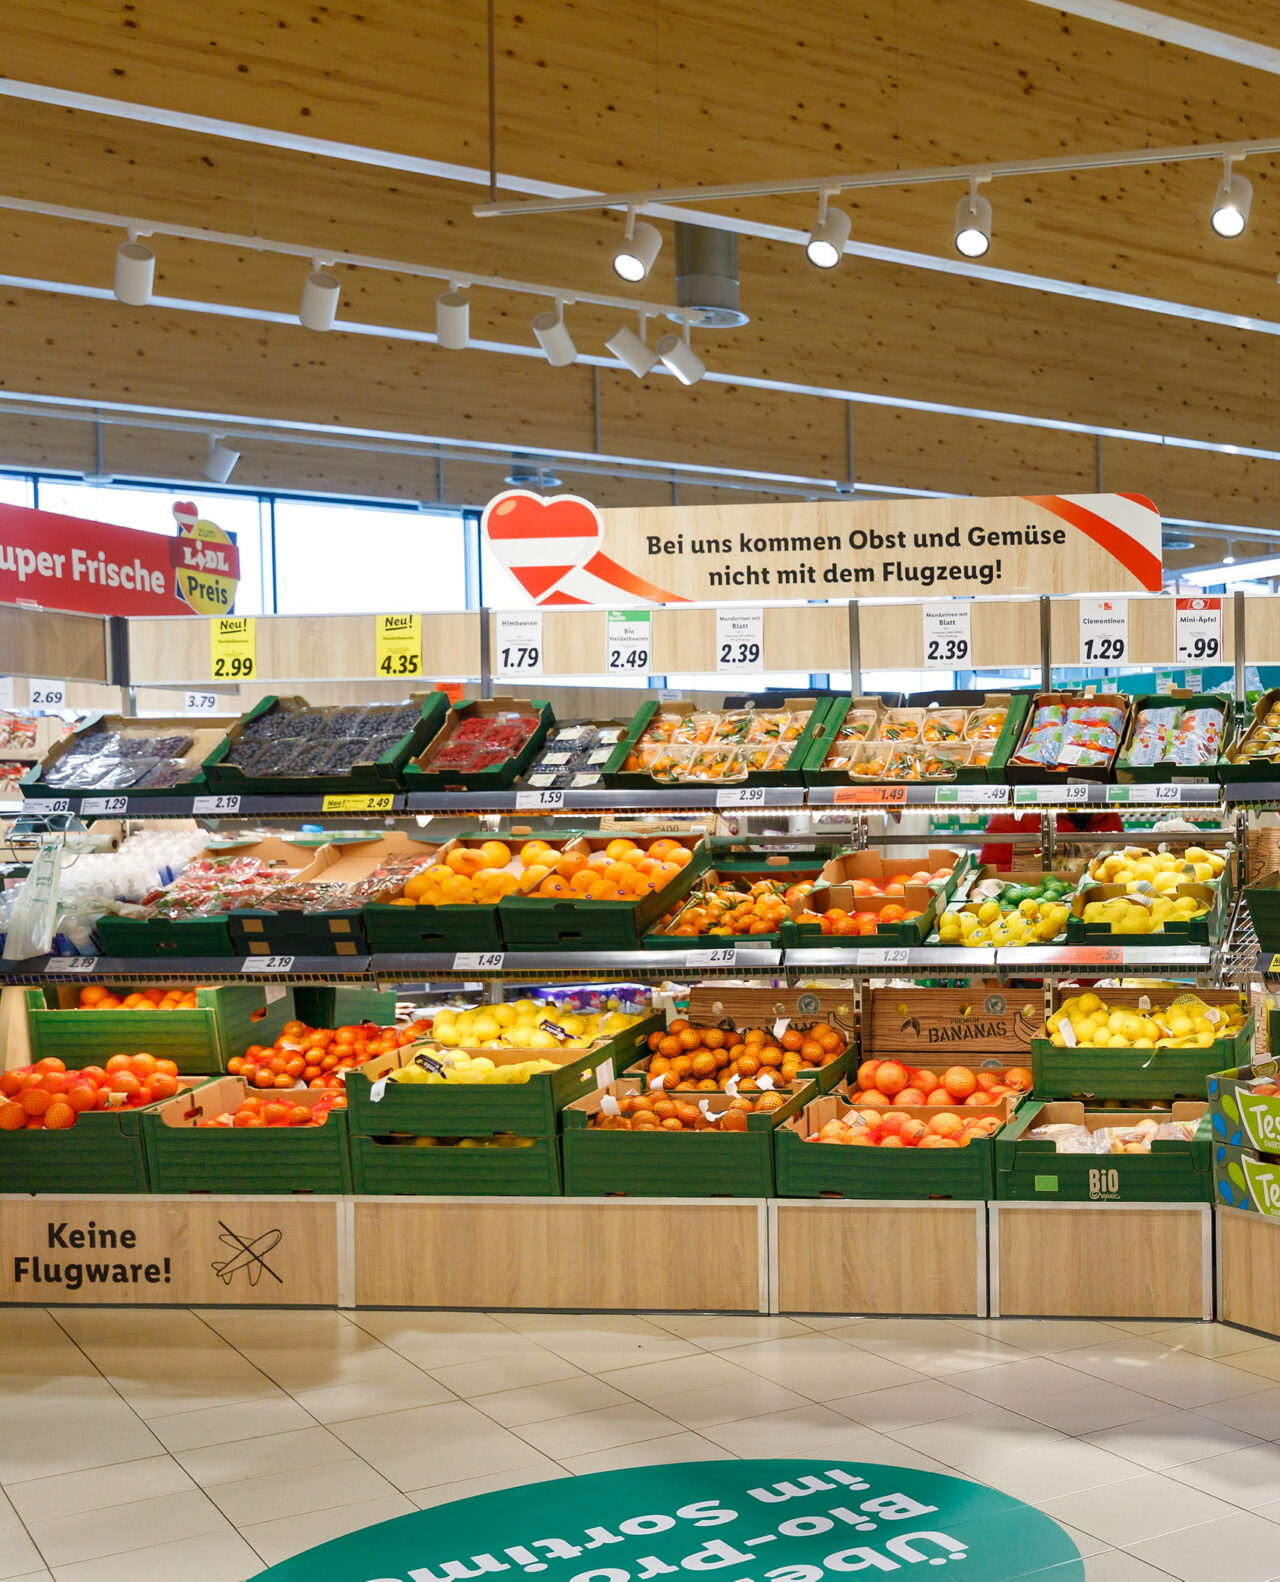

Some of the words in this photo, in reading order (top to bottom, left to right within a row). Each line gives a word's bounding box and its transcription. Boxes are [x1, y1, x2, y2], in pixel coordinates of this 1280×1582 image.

[198, 527, 216, 539] zum
[646, 533, 684, 556] Bei
[691, 538, 733, 555] uns
[739, 531, 842, 554] kommen
[848, 528, 907, 551] Obst
[913, 526, 960, 549] und
[967, 524, 1067, 548] Gemüse
[72, 548, 165, 594] Frische
[708, 564, 770, 586] nicht
[777, 562, 817, 585] mit
[822, 560, 875, 584] dem
[882, 558, 1002, 588] Flugzeug!
[187, 575, 228, 605] Preis
[220, 618, 247, 632] Neu!
[385, 614, 413, 629] Neu!
[1082, 617, 1125, 625] Clementinen
[720, 643, 760, 664] 2.39
[927, 639, 968, 661] 2.39
[1084, 638, 1125, 660] 1.29
[1179, 637, 1218, 659] -.99
[381, 654, 419, 675] 4.35
[501, 647, 539, 668] 1.79
[609, 650, 648, 668] 2.49
[214, 657, 253, 677] 2.99
[32, 691, 63, 704] 2.69
[187, 695, 216, 708] 3.79
[538, 789, 563, 804] 1.59
[739, 788, 763, 801] 2.99
[881, 788, 904, 800] 1.49
[1066, 787, 1087, 798] 1.99
[1155, 787, 1179, 798] 1.29
[104, 797, 126, 810] 1.29
[215, 796, 238, 808] 2.19
[366, 798, 391, 809] 2.49
[266, 957, 292, 968] 2.19
[478, 954, 502, 966] 1.49
[710, 949, 735, 961] 2.19
[882, 950, 908, 962] 1.29
[68, 957, 95, 969] 2.19
[928, 1021, 1007, 1044] BANANAS
[1263, 1139, 1280, 1149] SWEET
[47, 1220, 137, 1249] Keine
[14, 1256, 172, 1291] Flugware!
[746, 1468, 871, 1503] im
[365, 1499, 739, 1582] Sortim
